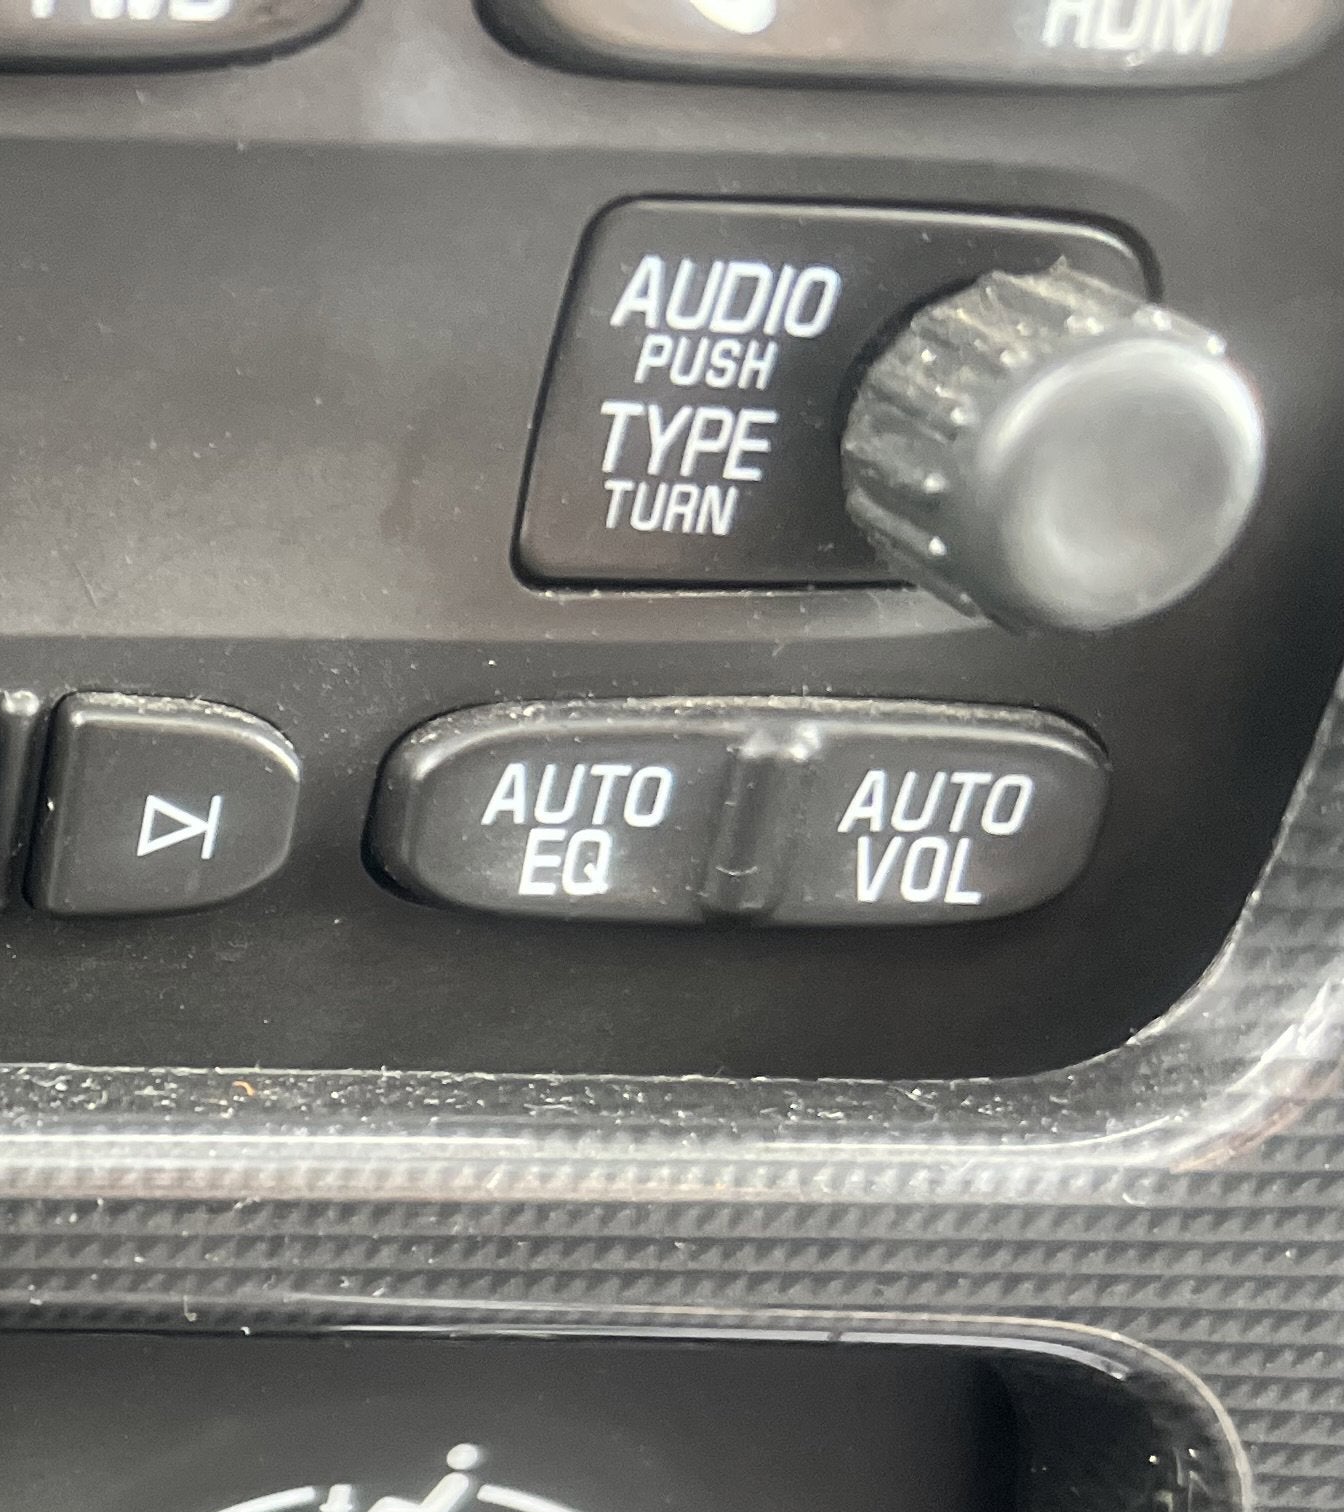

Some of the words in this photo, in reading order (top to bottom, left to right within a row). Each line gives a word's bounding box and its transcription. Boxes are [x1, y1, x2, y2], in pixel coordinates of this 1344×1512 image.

[609, 248, 842, 338] AUDIO
[634, 335, 777, 391] PUSH
[600, 401, 778, 482] TYPE
[604, 480, 739, 536] TURN
[480, 762, 674, 828] AUTO
[837, 769, 1035, 836] AUTO
[518, 828, 613, 896] EQ
[856, 835, 983, 905] VOL
